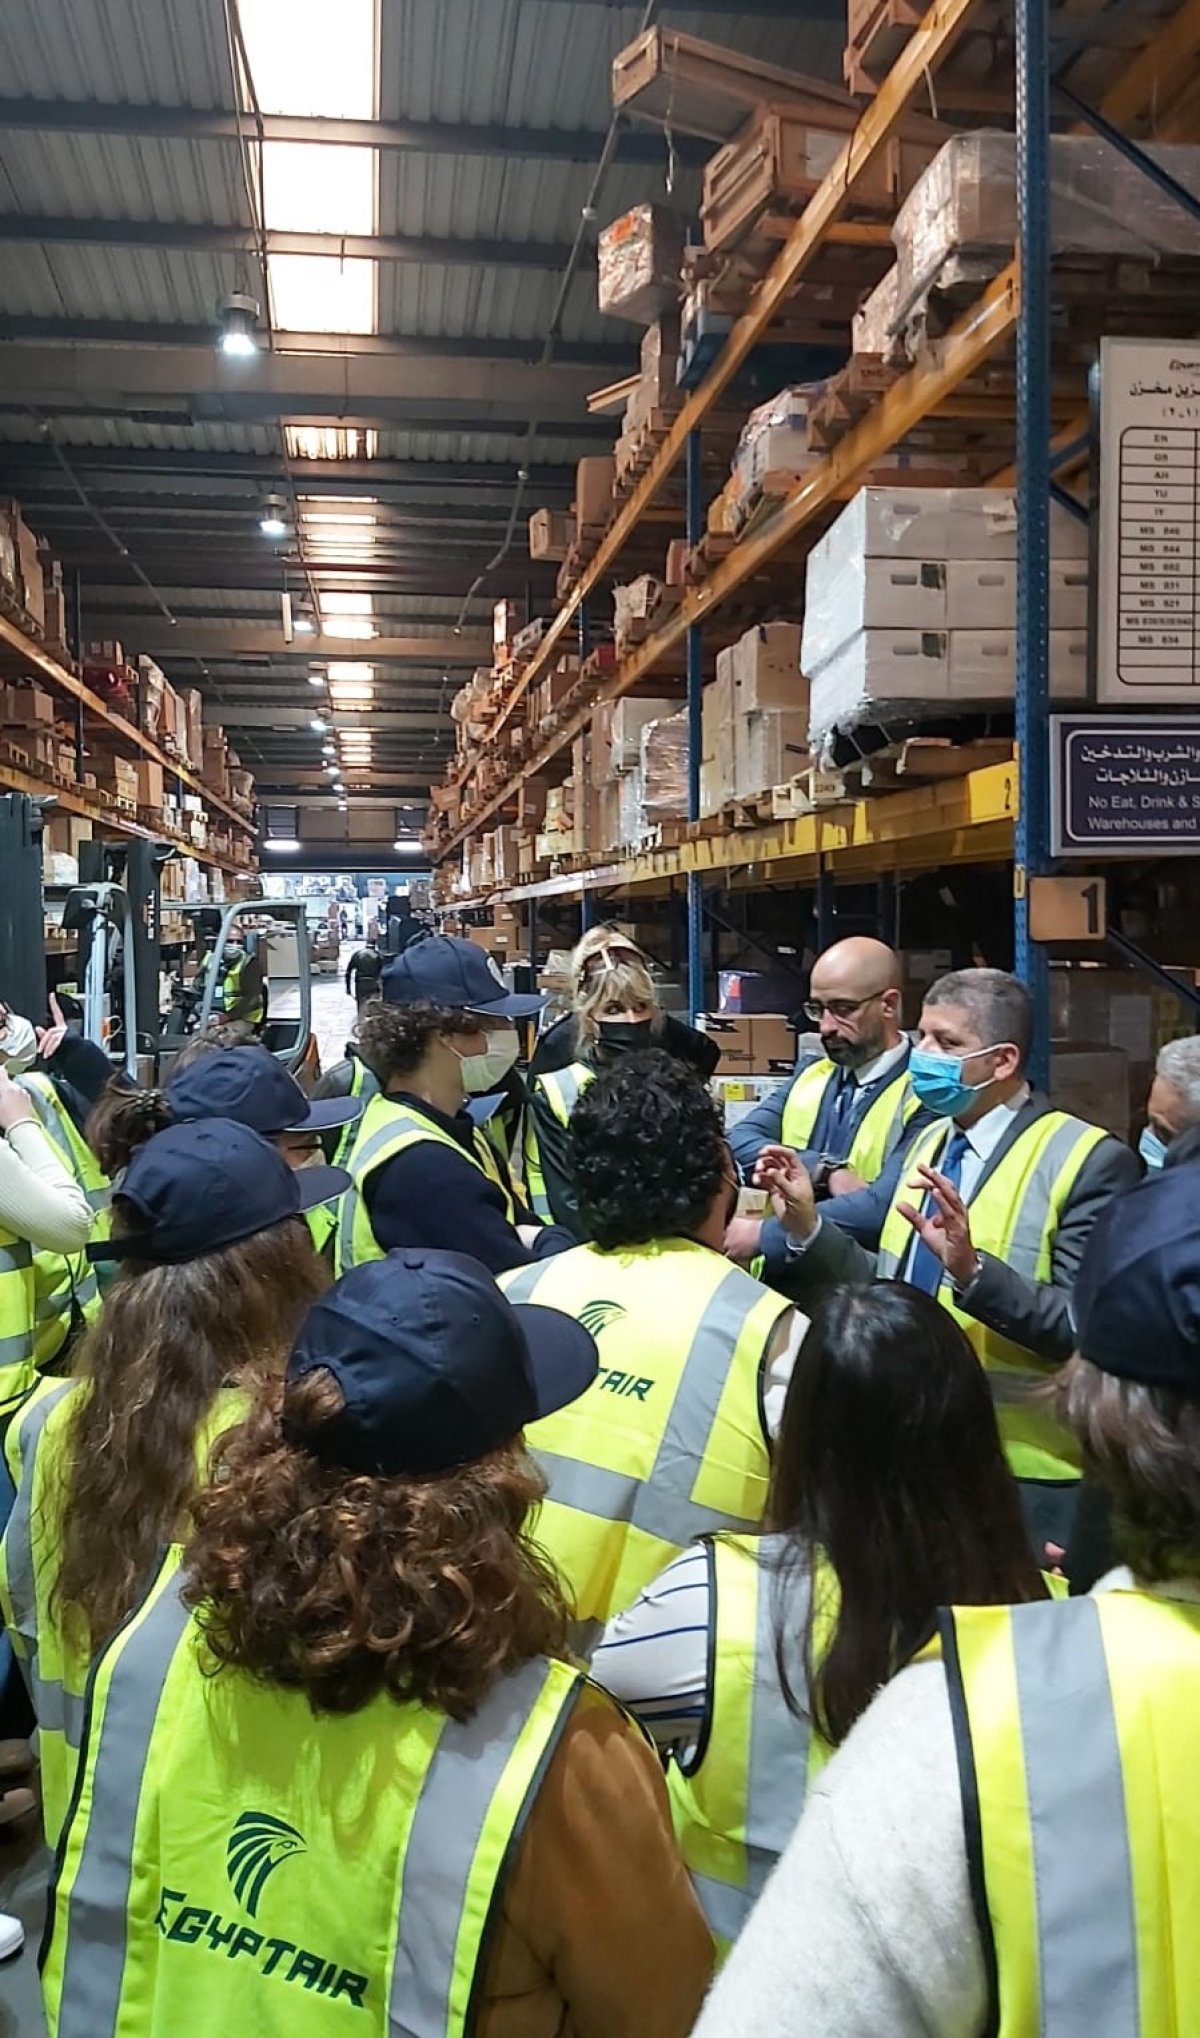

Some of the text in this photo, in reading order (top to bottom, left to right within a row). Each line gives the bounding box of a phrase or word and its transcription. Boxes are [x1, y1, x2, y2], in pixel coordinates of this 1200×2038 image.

[1088, 795, 1108, 808] No
[1140, 795, 1174, 808] Drink
[1178, 796, 1188, 808] &
[1087, 817, 1196, 830] Warehouses and
[1080, 883, 1099, 934] 1
